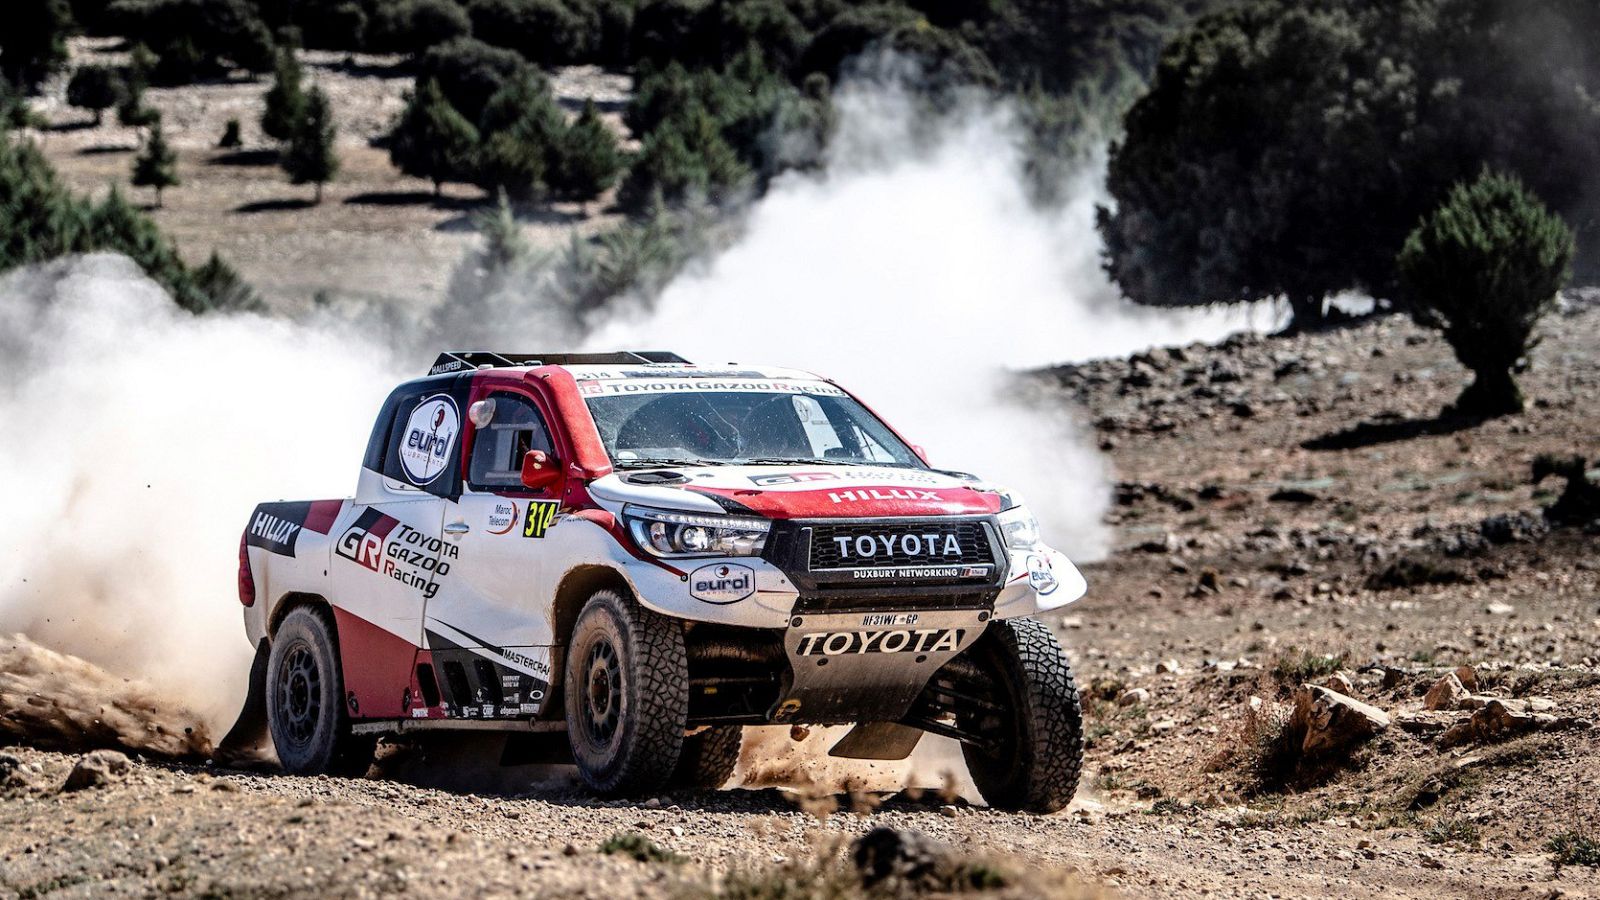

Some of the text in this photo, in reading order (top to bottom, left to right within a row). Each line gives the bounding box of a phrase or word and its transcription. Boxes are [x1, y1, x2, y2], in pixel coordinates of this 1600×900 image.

[432, 361, 462, 374] HALLSPEED
[607, 383, 693, 393] TOYOTA
[695, 381, 770, 390] GAZOO
[772, 383, 847, 397] Racing
[407, 429, 453, 459] eurol
[827, 489, 945, 504] HILUX
[488, 515, 510, 526] Telecom
[495, 504, 512, 515] Maroc
[525, 502, 556, 537] 314
[251, 511, 301, 545] HILUX
[337, 526, 382, 570] GR
[397, 524, 460, 560] TOYOTA
[833, 534, 962, 558] TOYOTA
[386, 541, 450, 576] GAZOO
[383, 559, 440, 599] Racing
[696, 573, 750, 592] eurol
[853, 568, 958, 579] DUXBURY NETWORKING
[862, 613, 919, 626] HF31WF GP
[802, 628, 959, 657] TOYOTA
